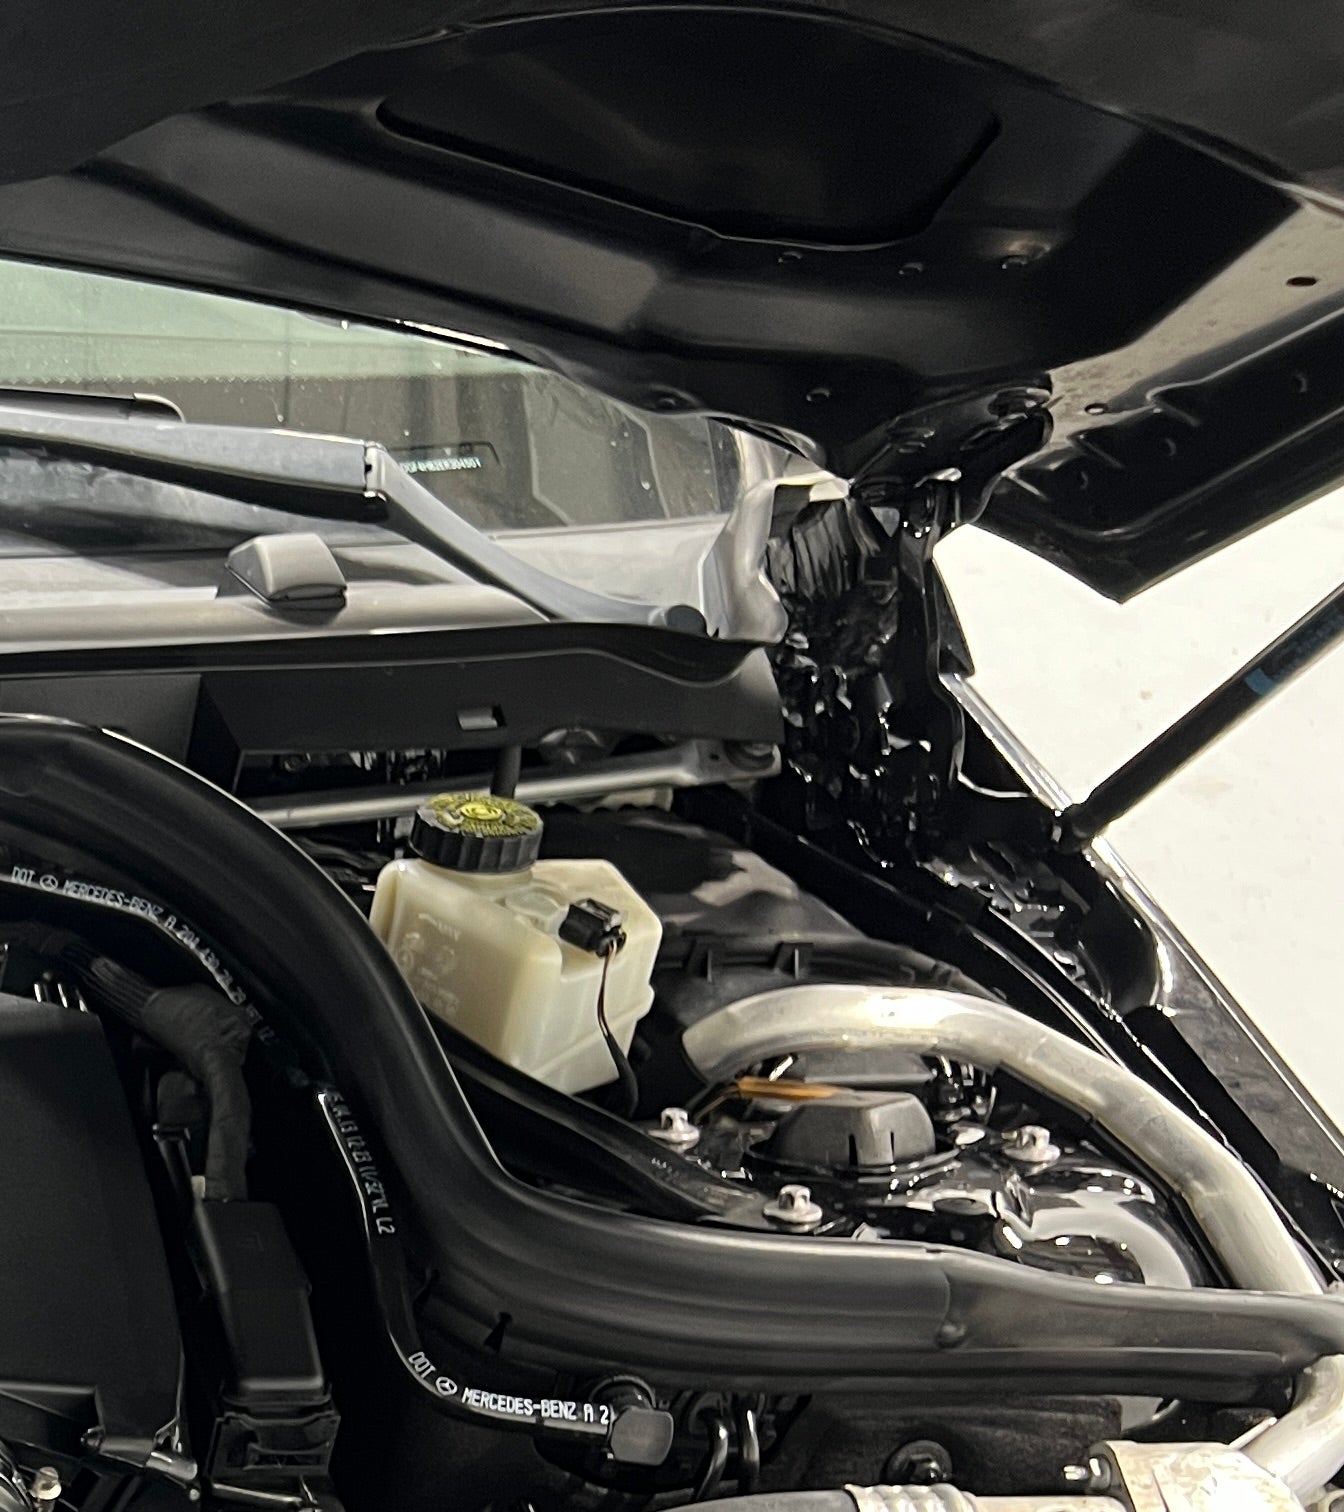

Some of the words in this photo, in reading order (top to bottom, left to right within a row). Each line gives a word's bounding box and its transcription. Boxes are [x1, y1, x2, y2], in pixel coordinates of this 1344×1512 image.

[62, 880, 164, 922] MERCEDES-BENZ
[408, 1351, 436, 1379] DOT
[461, 1386, 578, 1421] MERCEDES-BENZ
[583, 1402, 595, 1424] A
